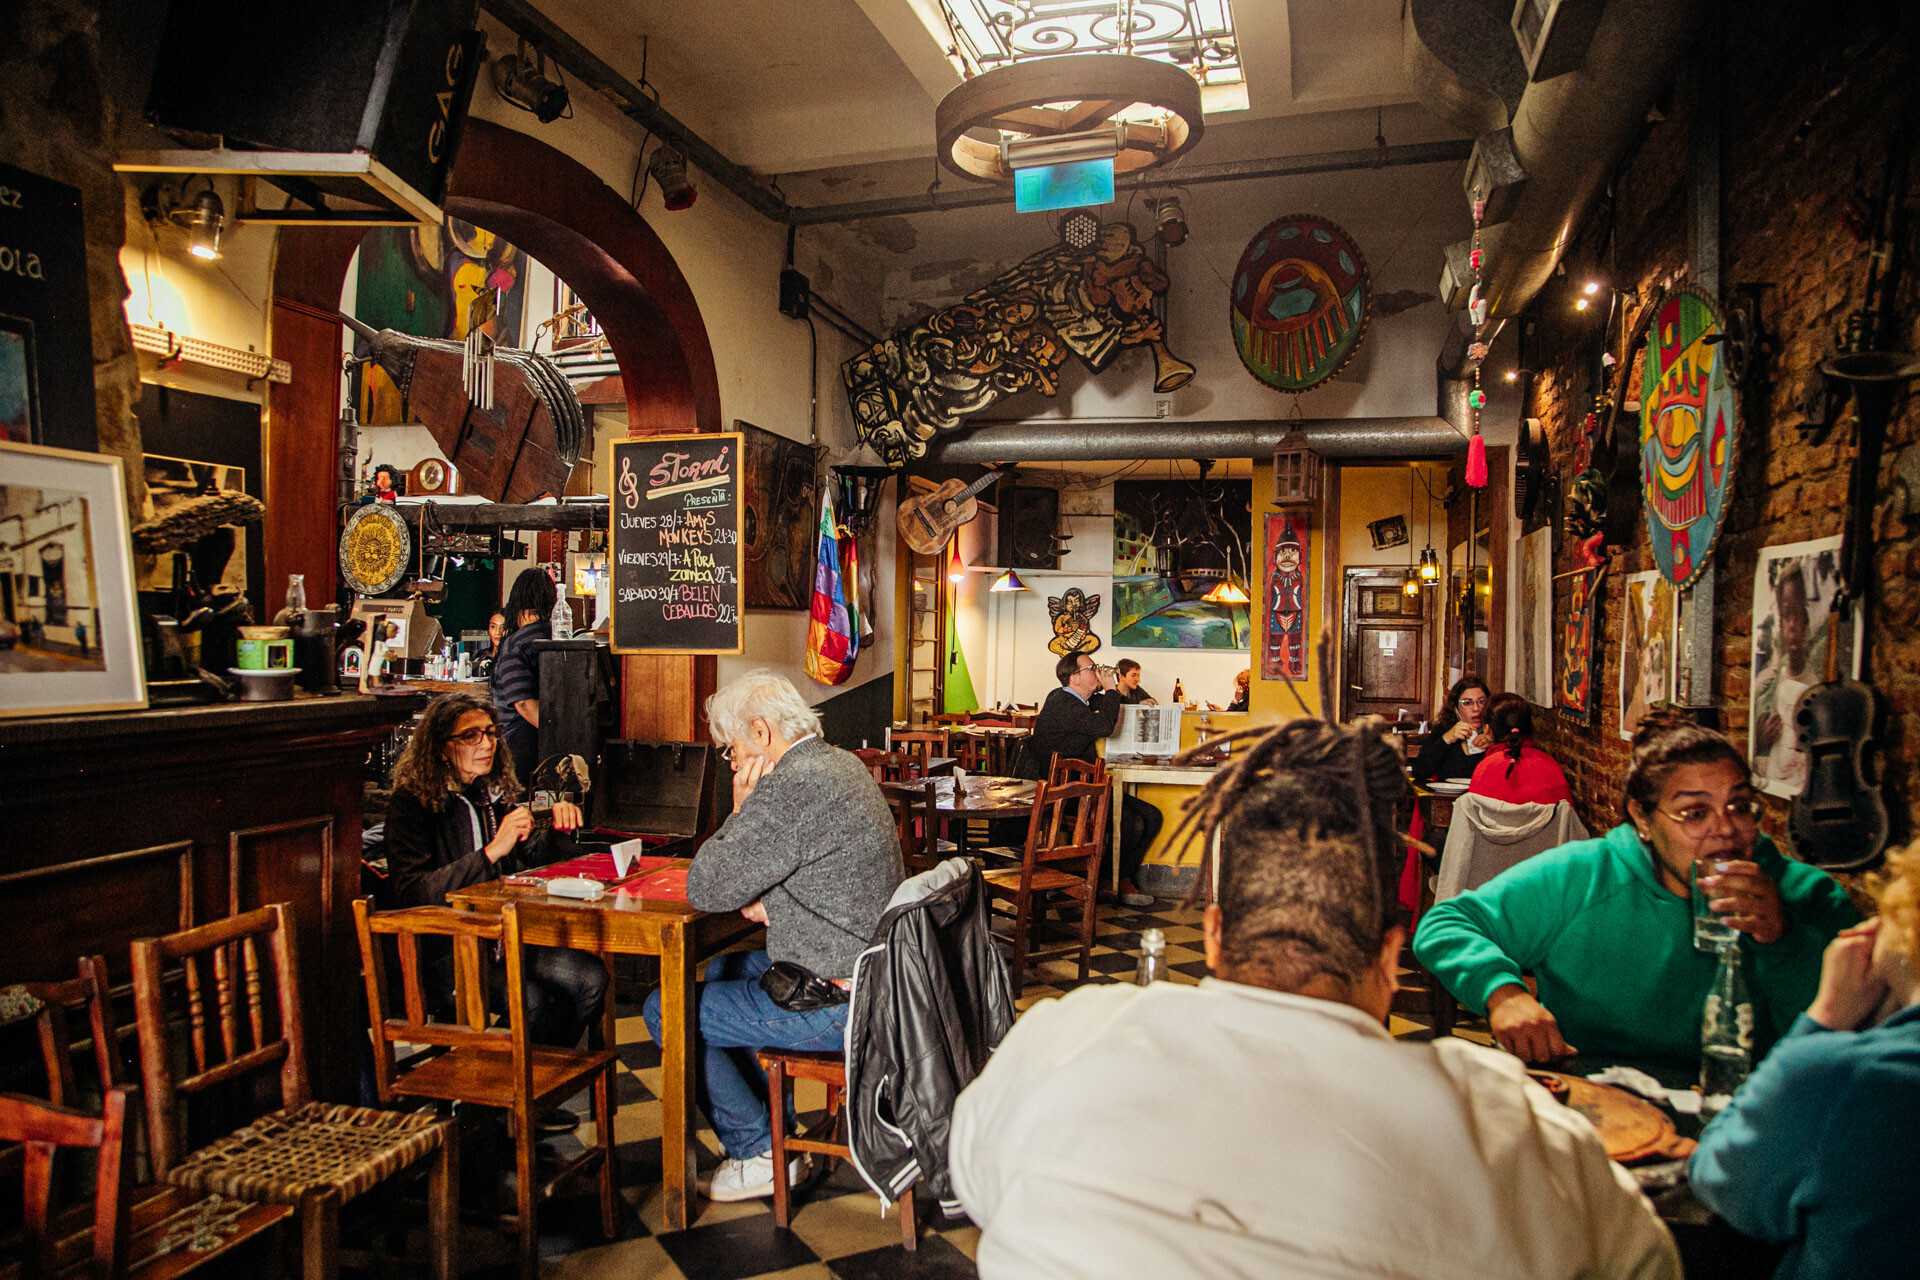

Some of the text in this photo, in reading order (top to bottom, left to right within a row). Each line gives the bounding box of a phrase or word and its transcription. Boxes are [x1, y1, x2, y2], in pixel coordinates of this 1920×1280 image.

[620, 512, 657, 529] JUEVES
[659, 528, 713, 548] MONKEYS
[618, 549, 658, 567] VIERNES
[683, 549, 691, 567] A
[690, 548, 716, 568] PURA
[618, 588, 657, 602] SABADO
[679, 584, 720, 603] BELEN
[662, 603, 718, 621] CEBALLOS
